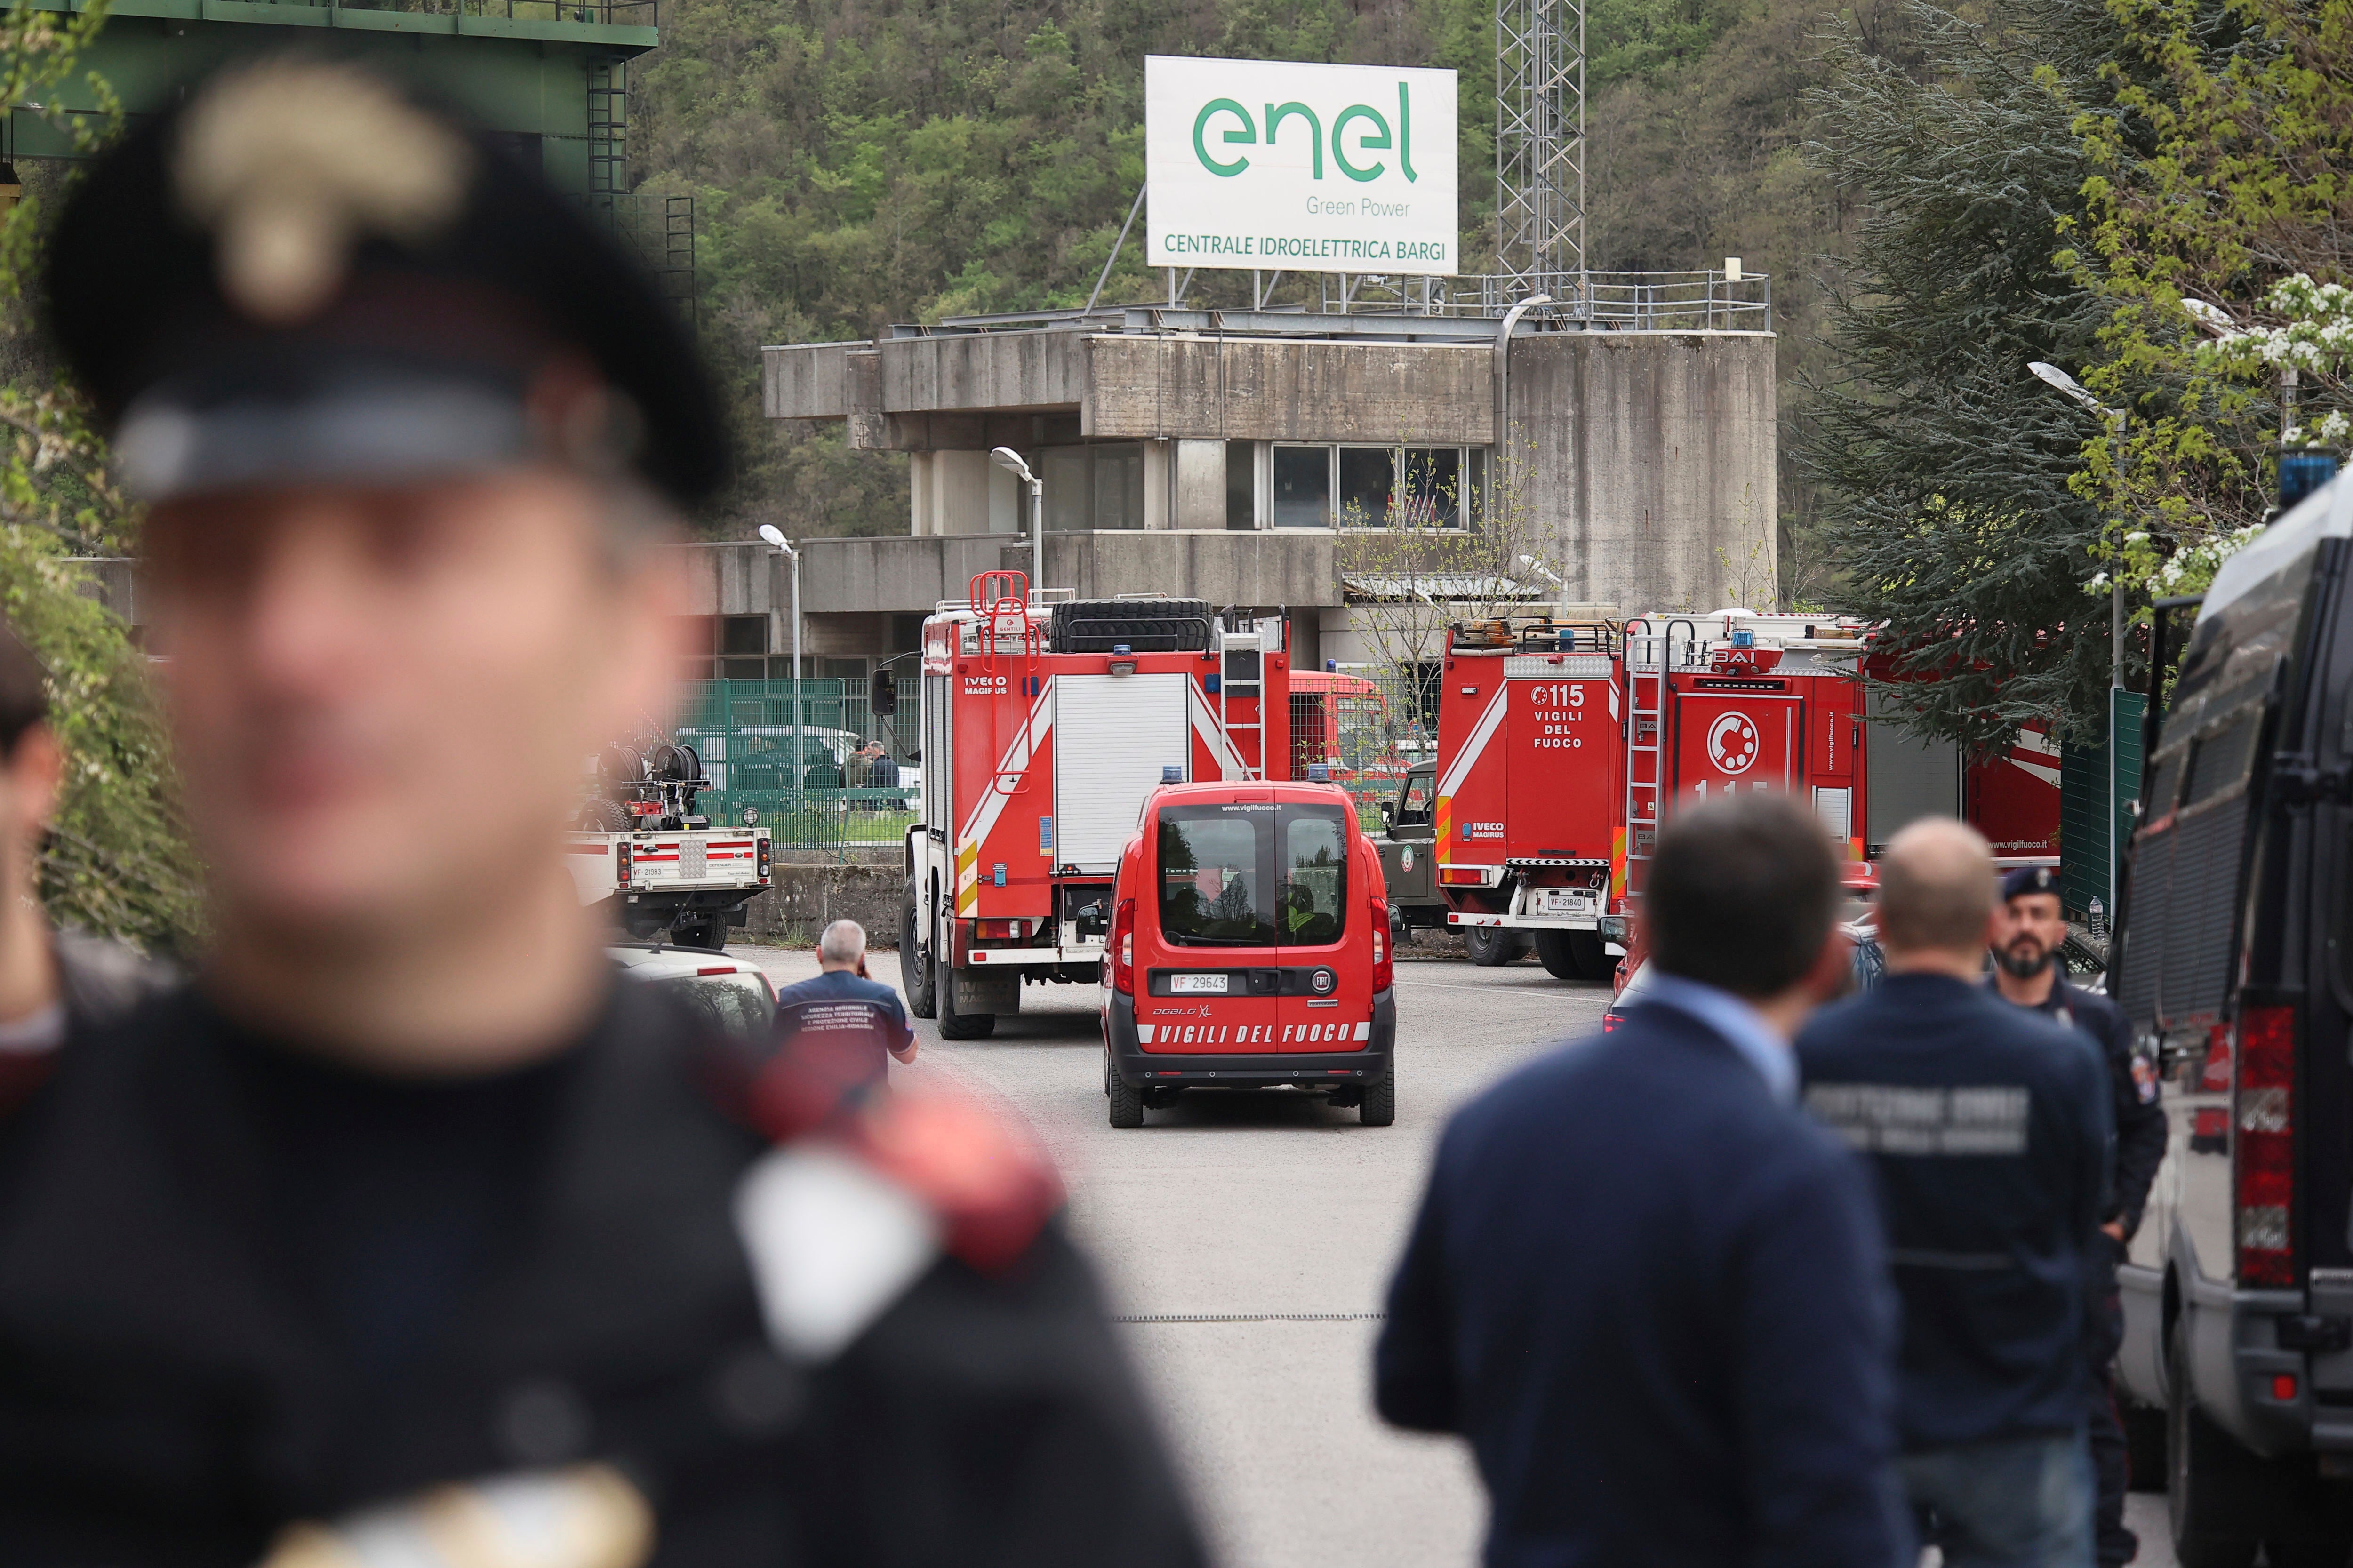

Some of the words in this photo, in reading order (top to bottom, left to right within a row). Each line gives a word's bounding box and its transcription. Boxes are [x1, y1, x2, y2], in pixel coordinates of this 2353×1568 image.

[1193, 81, 1417, 183] enel
[1306, 196, 1354, 215] Green
[1362, 198, 1410, 217] Power
[1165, 234, 1253, 254] CENTRALE
[1260, 237, 1390, 259] IDROELETTRICA
[1397, 241, 1445, 260] BARGI
[1713, 651, 1755, 663] BAI
[1550, 685, 1585, 707] 115
[1534, 712, 1582, 721] VIGILI
[1545, 725, 1571, 734] DEL
[1534, 738, 1582, 748] FUOCO
[1222, 804, 1281, 812] www.vigilfuoco.it
[1473, 823, 1504, 831] IVECO
[1988, 840, 2047, 850] www.vigilfuoco.it
[1174, 977, 1185, 988] VF
[1193, 977, 1225, 989] 29643
[1316, 976, 1328, 986] FIAT
[1198, 1004, 1212, 1018] XL
[1160, 1026, 1227, 1043] VIGILI
[1235, 1025, 1273, 1043] DEL
[1282, 1023, 1349, 1043] FUOCO
